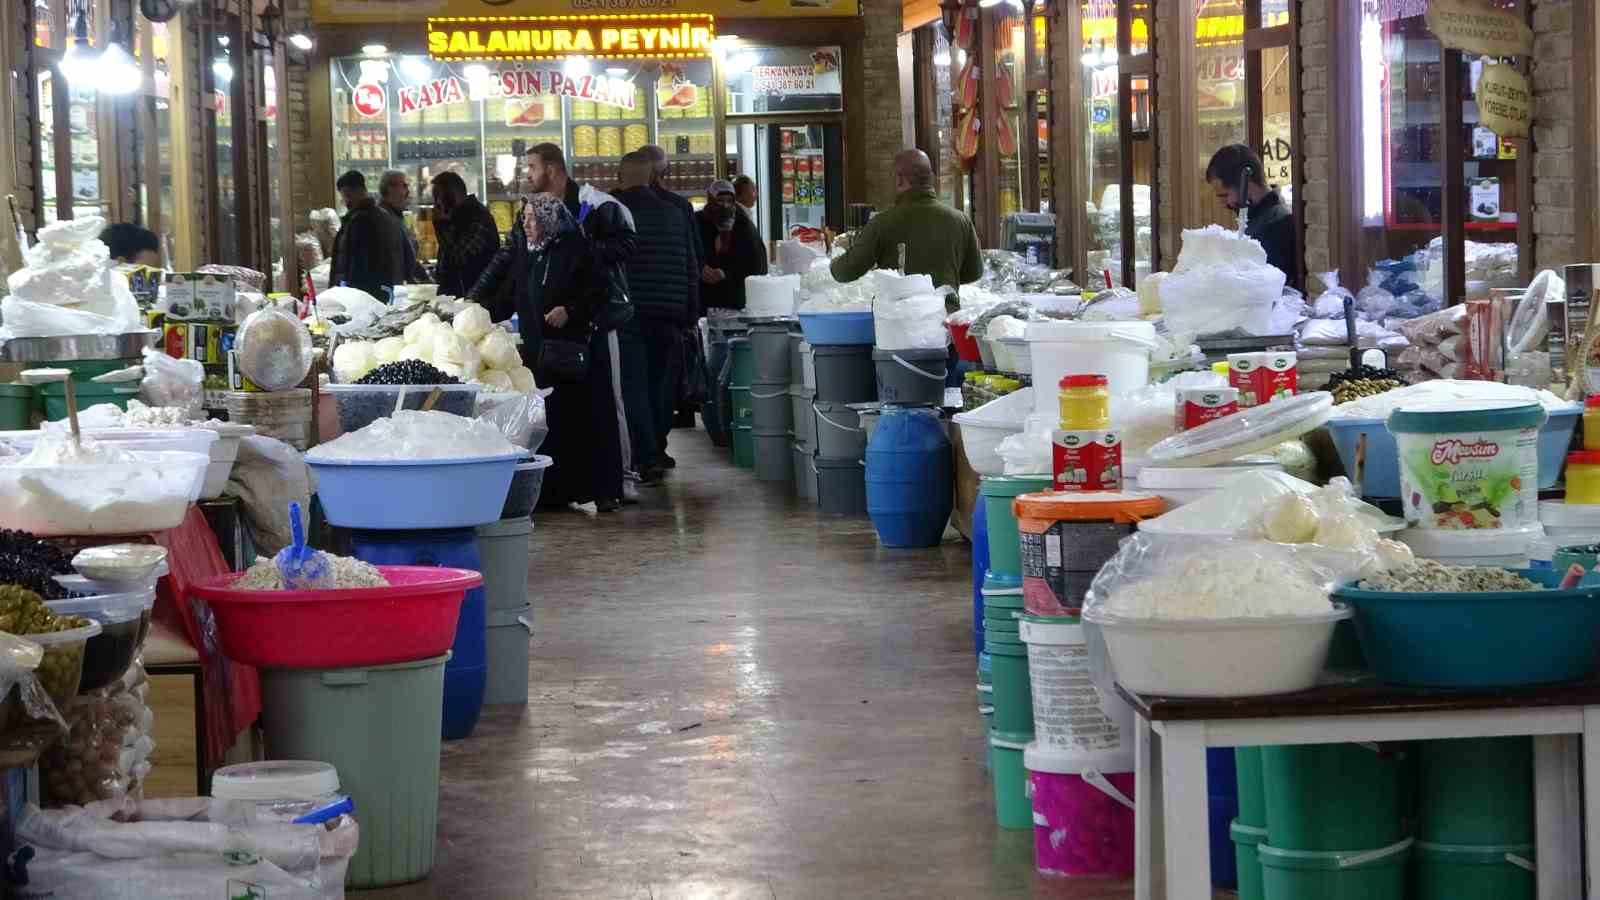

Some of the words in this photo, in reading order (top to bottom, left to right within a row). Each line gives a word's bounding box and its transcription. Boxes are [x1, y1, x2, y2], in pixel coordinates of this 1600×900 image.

[429, 30, 595, 53] SALAMURA
[601, 23, 711, 50] PEYNİR
[400, 79, 462, 113] KAYA
[1280, 165, 1288, 178] &
